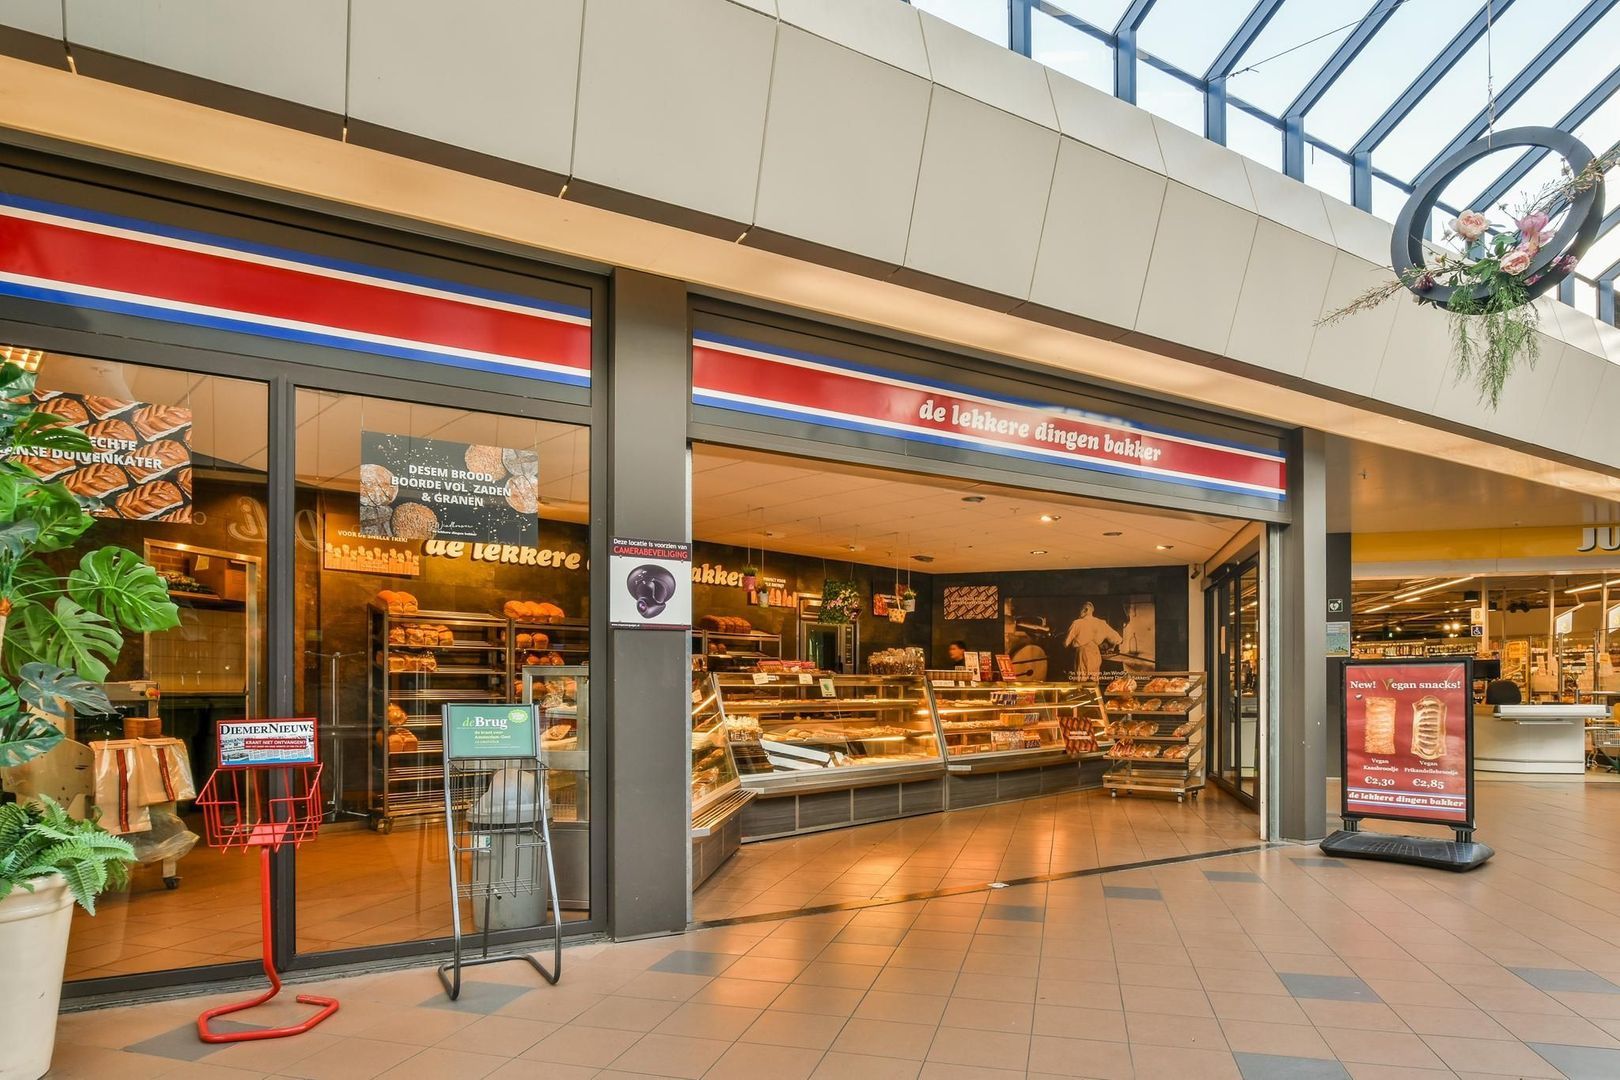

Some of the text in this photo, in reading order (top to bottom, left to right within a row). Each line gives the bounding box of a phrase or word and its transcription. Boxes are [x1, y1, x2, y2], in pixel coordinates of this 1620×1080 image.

[919, 400, 1162, 461] de lekkere dingen bakker
[52, 448, 163, 470] DUIVENKATER
[409, 465, 496, 484] DESEM BROOD,
[391, 476, 512, 496] BOORDE VOL ZADEN
[421, 492, 484, 507] & GRANEN
[338, 530, 357, 538] VOOR
[473, 543, 581, 570] lekkere
[613, 545, 688, 559] CAMERABEVEILIGING
[692, 563, 745, 587] akker
[1349, 681, 1376, 689] New!
[1419, 680, 1461, 689] snacks!
[1364, 776, 1395, 787] €2,30
[1412, 778, 1445, 790] €2,85
[1361, 792, 1394, 802] lekkere
[1395, 795, 1428, 805] dingen
[1430, 798, 1464, 807] bakker
